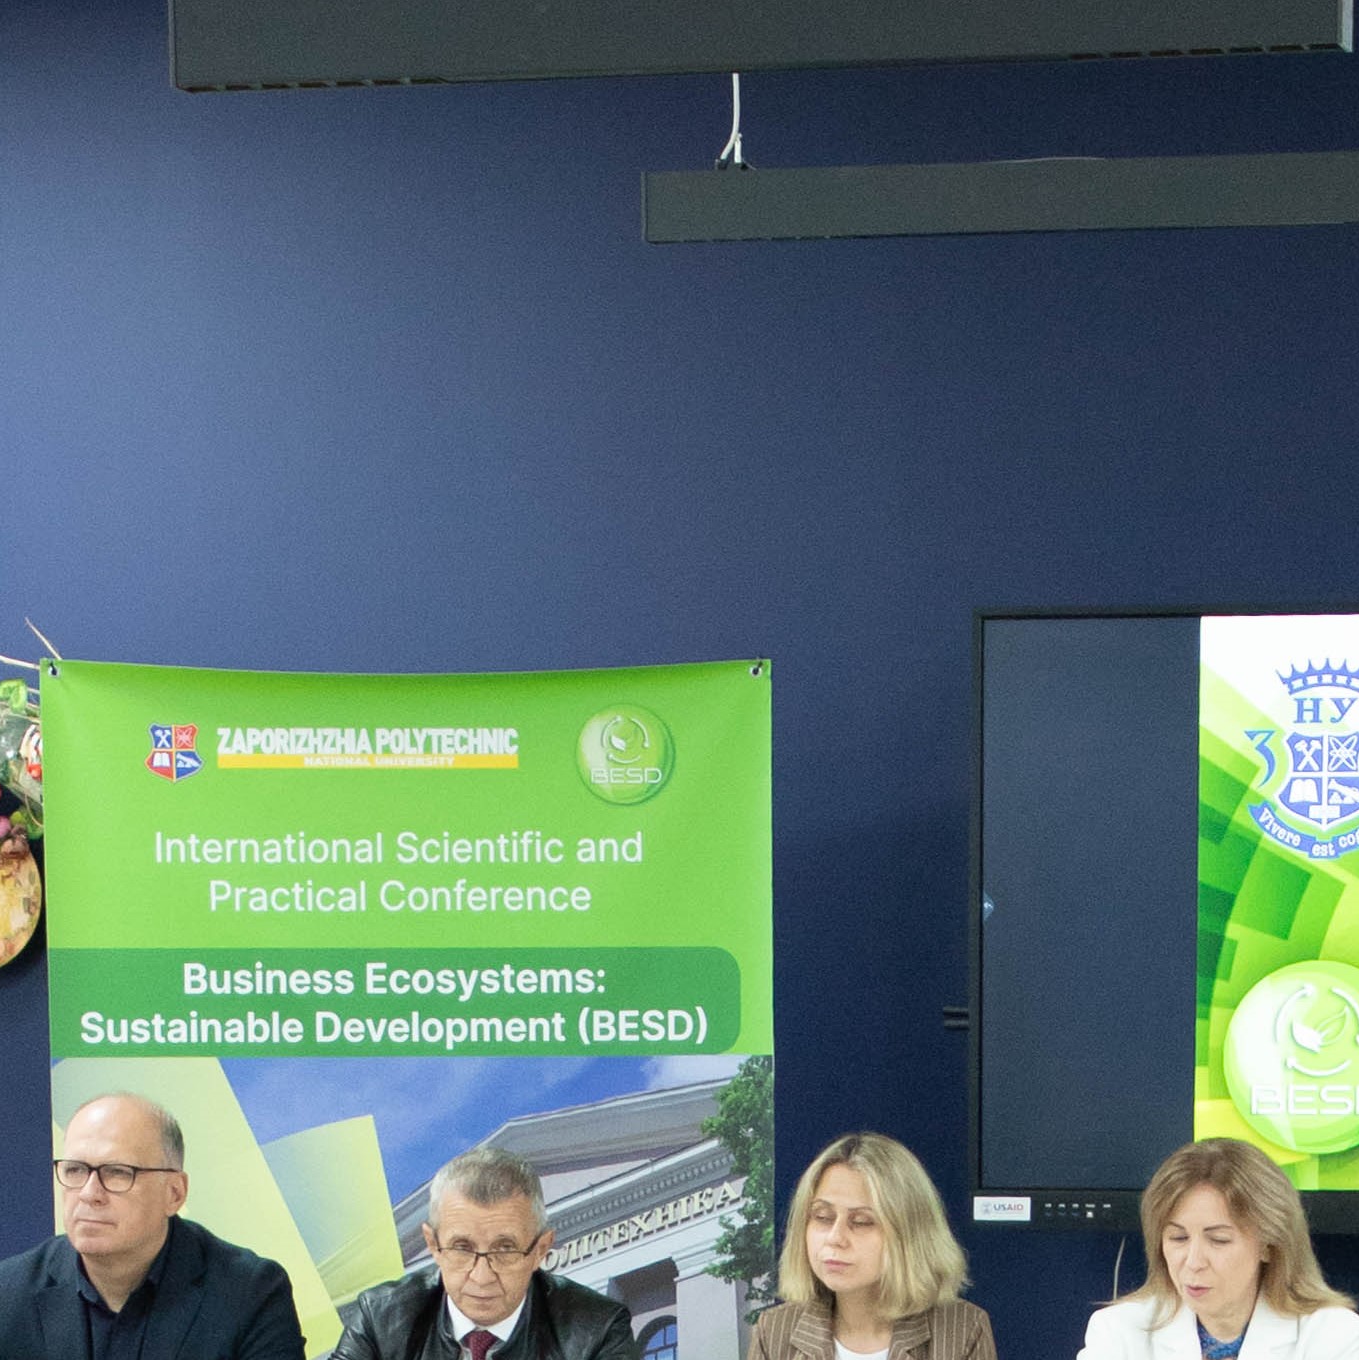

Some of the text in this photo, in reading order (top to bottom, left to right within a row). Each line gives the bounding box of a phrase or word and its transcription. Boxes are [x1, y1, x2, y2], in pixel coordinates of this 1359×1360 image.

[217, 728, 518, 755] ZAPORIZHZHIA POLYTECHNIC
[303, 756, 455, 768] NATIONAL UNIVERSITY
[589, 767, 663, 785] BESD
[154, 829, 643, 864] International Scientific and
[1258, 807, 1302, 847] Vivere
[1311, 842, 1335, 857] est
[210, 879, 592, 913] Practical Conference
[183, 962, 607, 1002] Business Ecosystems:
[80, 1008, 709, 1050] Sustainable Development (BESD)
[993, 1203, 1024, 1212] USAID
[540, 1181, 741, 1272] ОЛІТЕХНІКА
